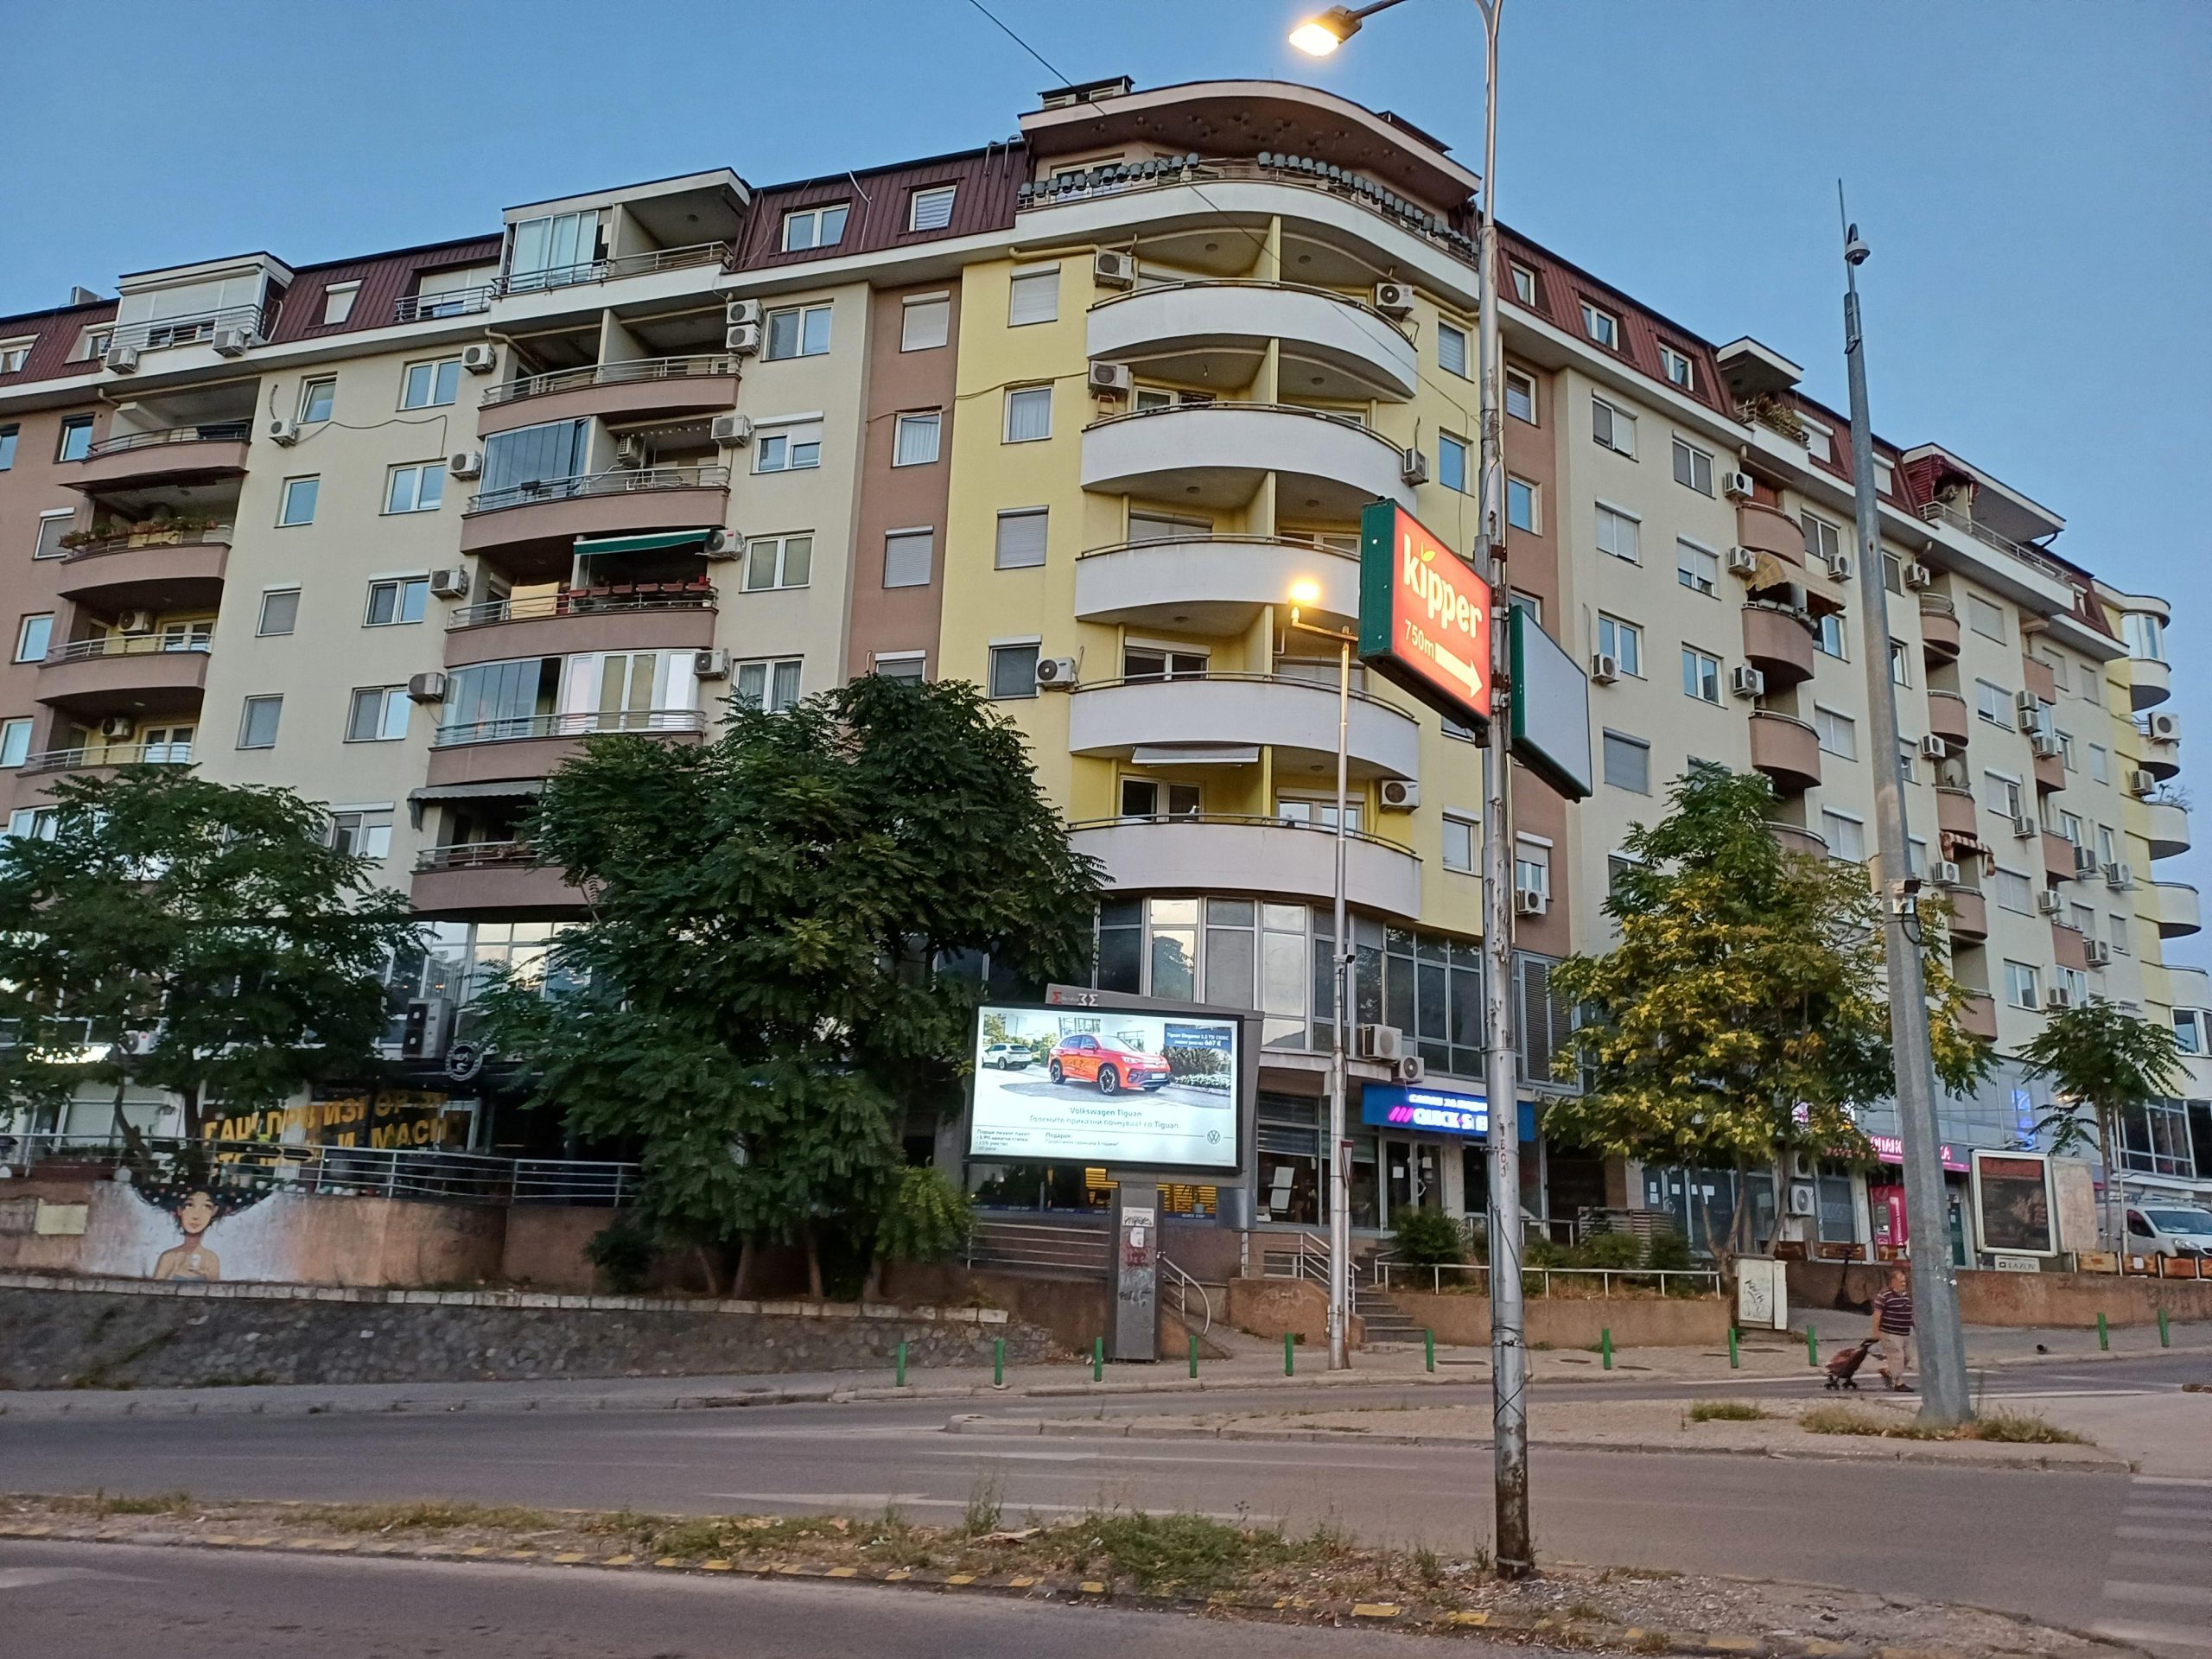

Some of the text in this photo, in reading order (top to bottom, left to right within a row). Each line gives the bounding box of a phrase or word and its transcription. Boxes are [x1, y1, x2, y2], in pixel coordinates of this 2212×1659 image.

[1403, 532, 1483, 639] kipper
[1404, 618, 1435, 660] 750m
[1029, 1115, 1065, 1123] Големите
[1154, 1121, 1179, 1129] Tiguan
[1070, 1107, 1142, 1118] Volkswagen Tiguan
